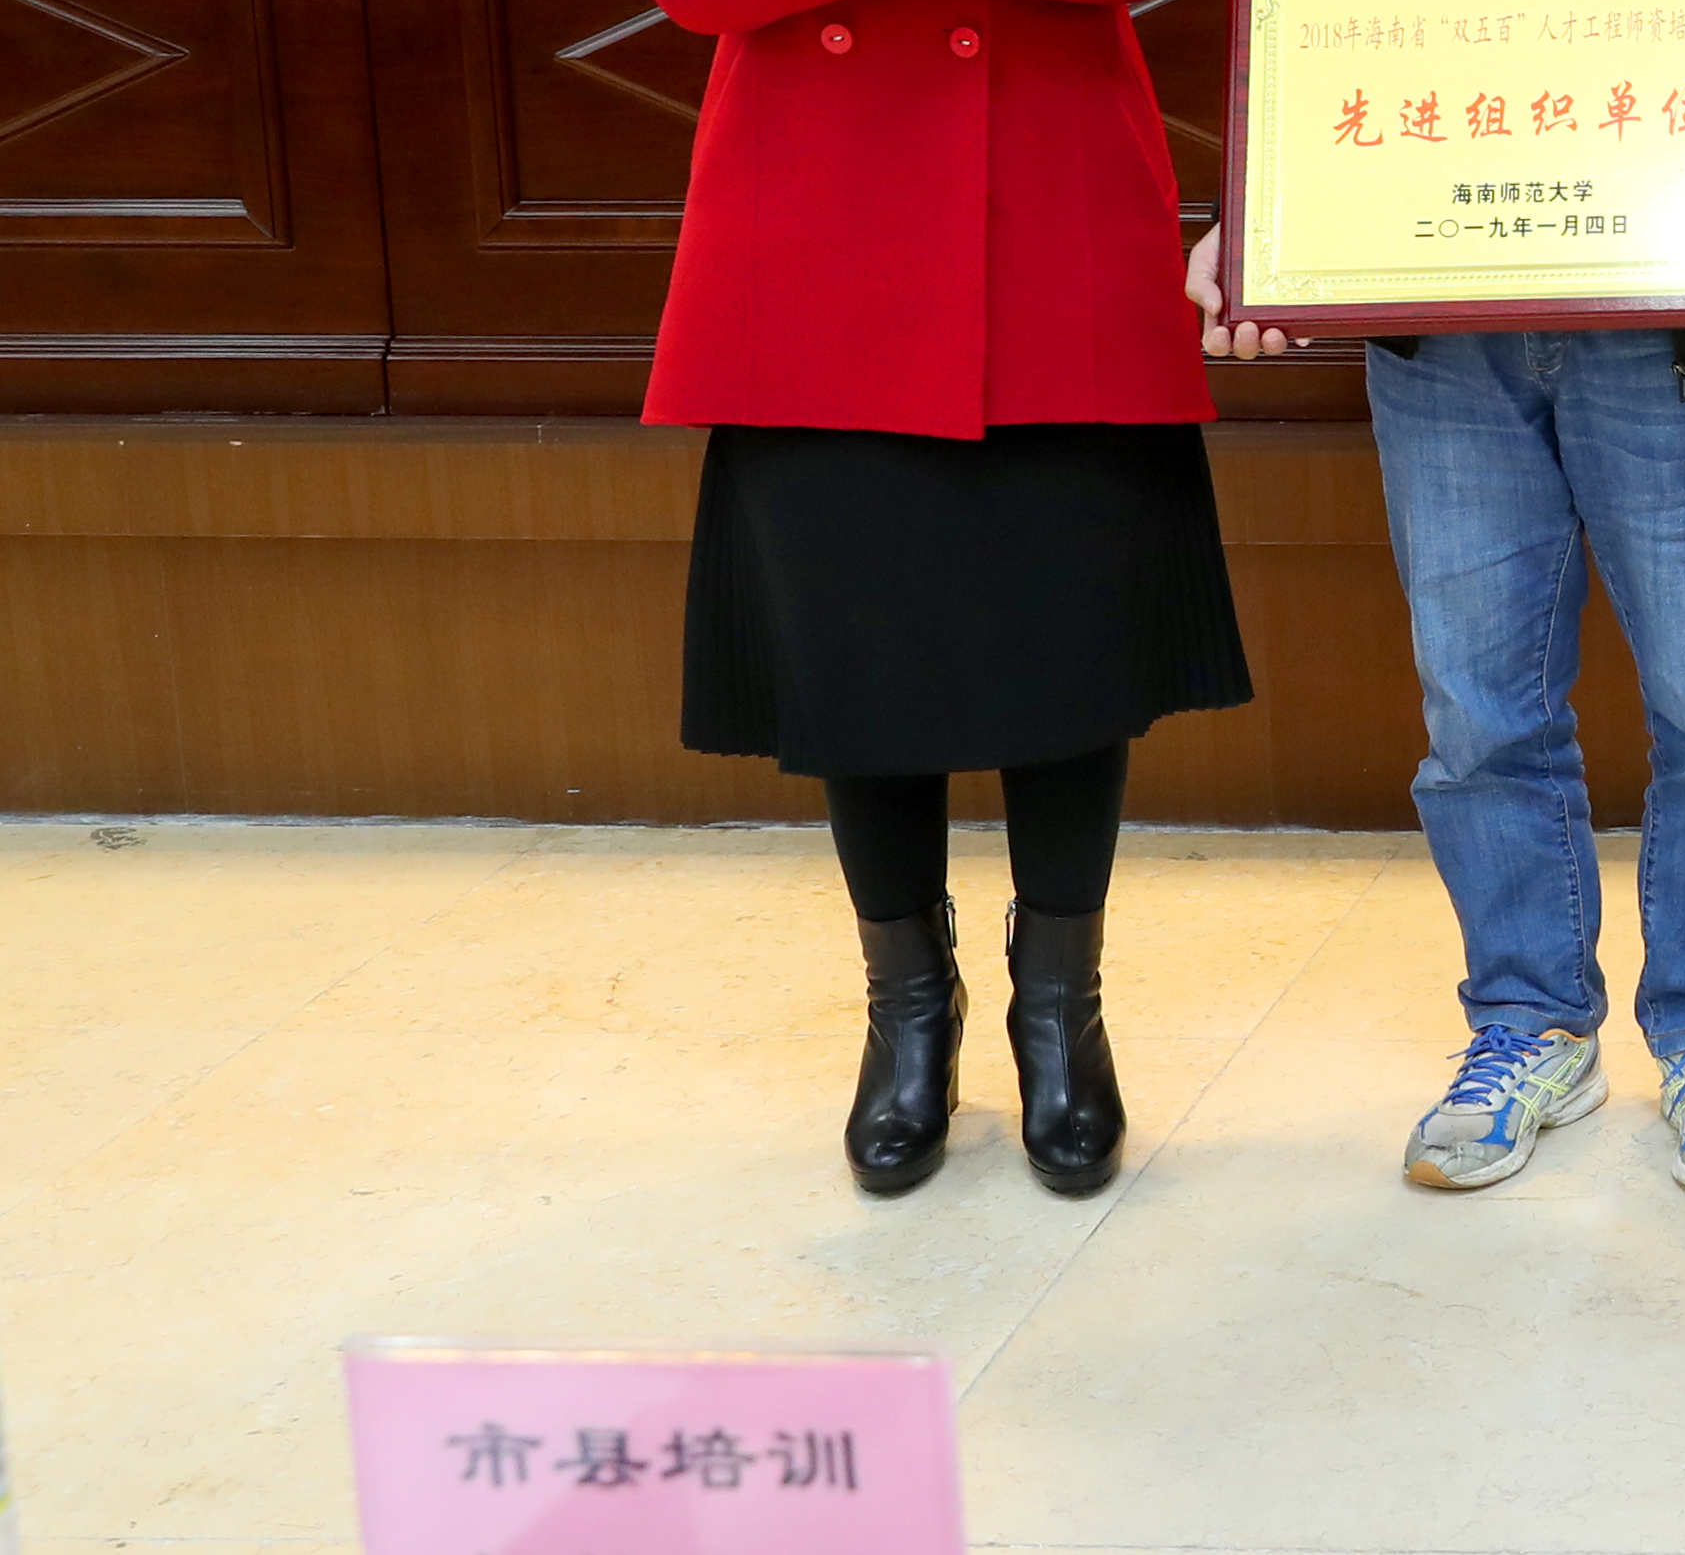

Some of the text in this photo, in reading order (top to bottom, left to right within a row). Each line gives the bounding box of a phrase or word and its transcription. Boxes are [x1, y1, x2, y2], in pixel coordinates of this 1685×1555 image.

[1451, 180, 1594, 206] 海南师范大学
[446, 1421, 860, 1493] 市县培训
